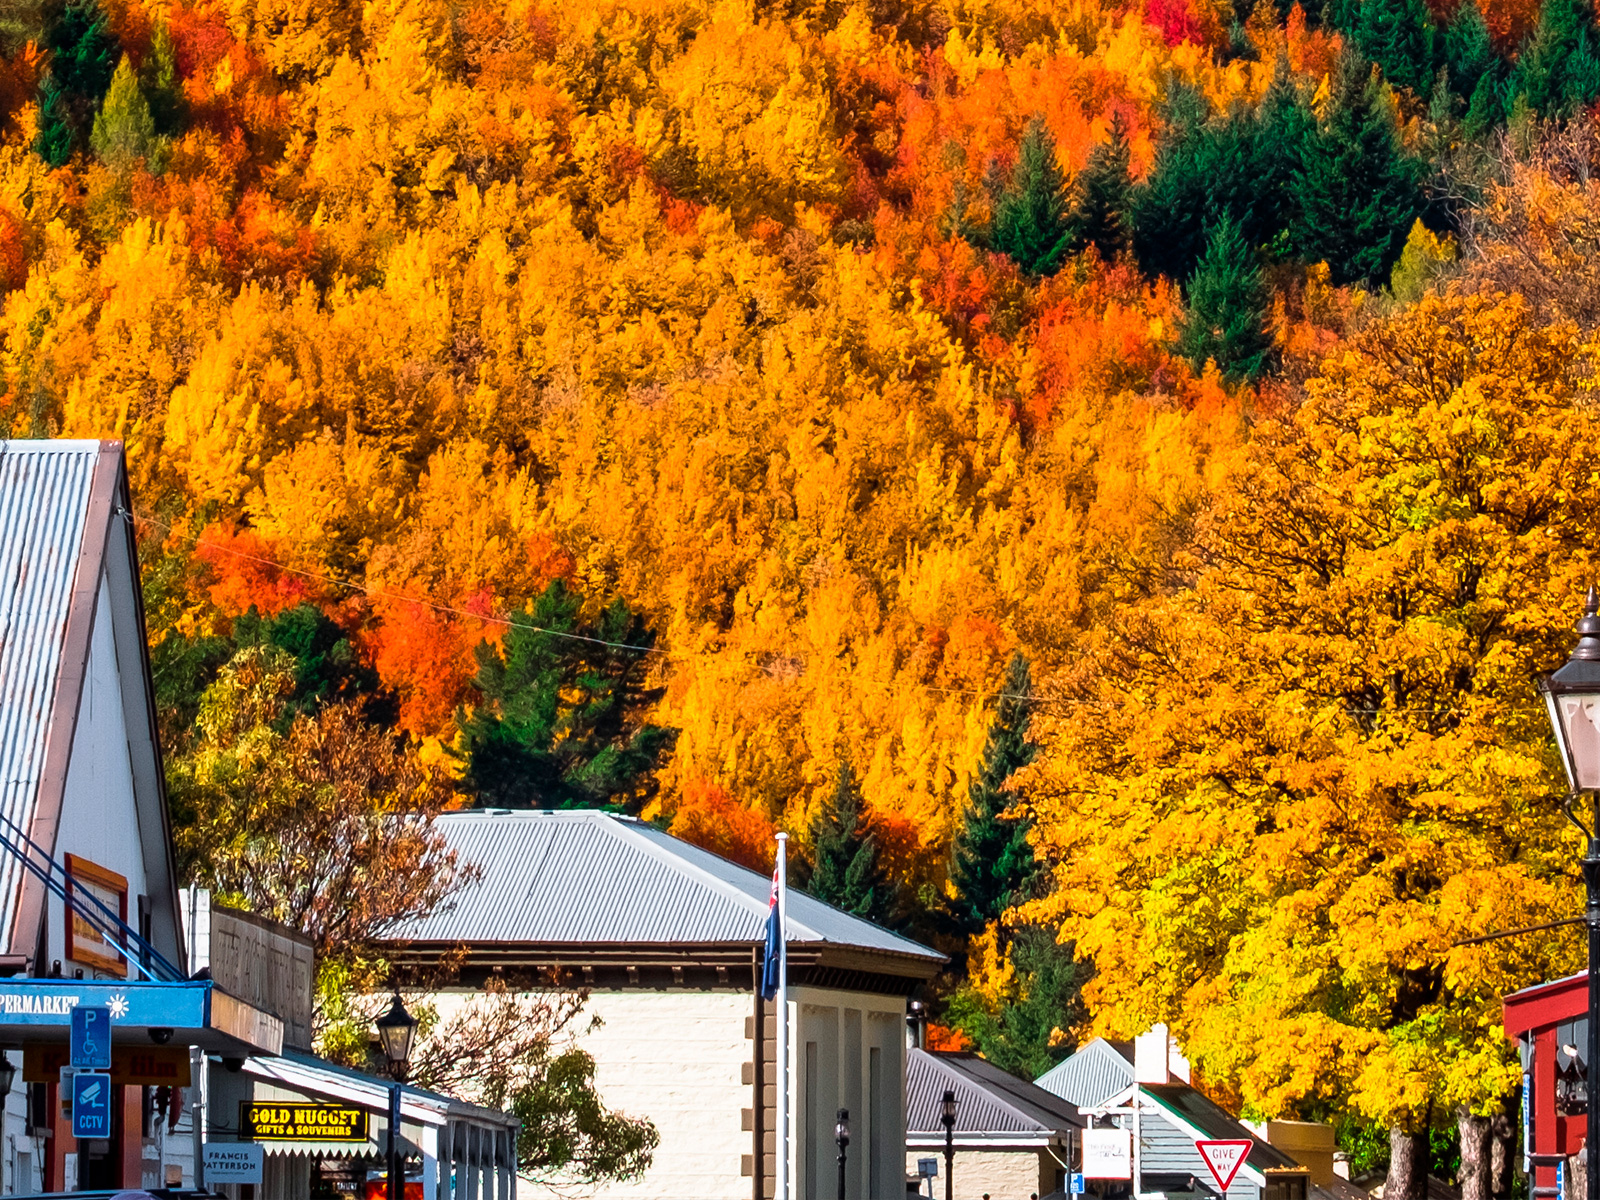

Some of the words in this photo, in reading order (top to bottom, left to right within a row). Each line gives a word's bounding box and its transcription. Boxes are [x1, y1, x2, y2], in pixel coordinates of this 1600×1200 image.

[85, 1010, 97, 1029] P
[79, 1115, 103, 1129] CCTV
[249, 1108, 291, 1125] GOLD
[294, 1109, 360, 1125] NUGGET
[255, 1124, 285, 1134] GIFTS
[286, 1125, 295, 1135] &
[296, 1125, 351, 1136] SOUVENIRS
[209, 1152, 249, 1161] FRANCIS
[1212, 1148, 1235, 1159] GIVE
[1217, 1163, 1231, 1171] WAY
